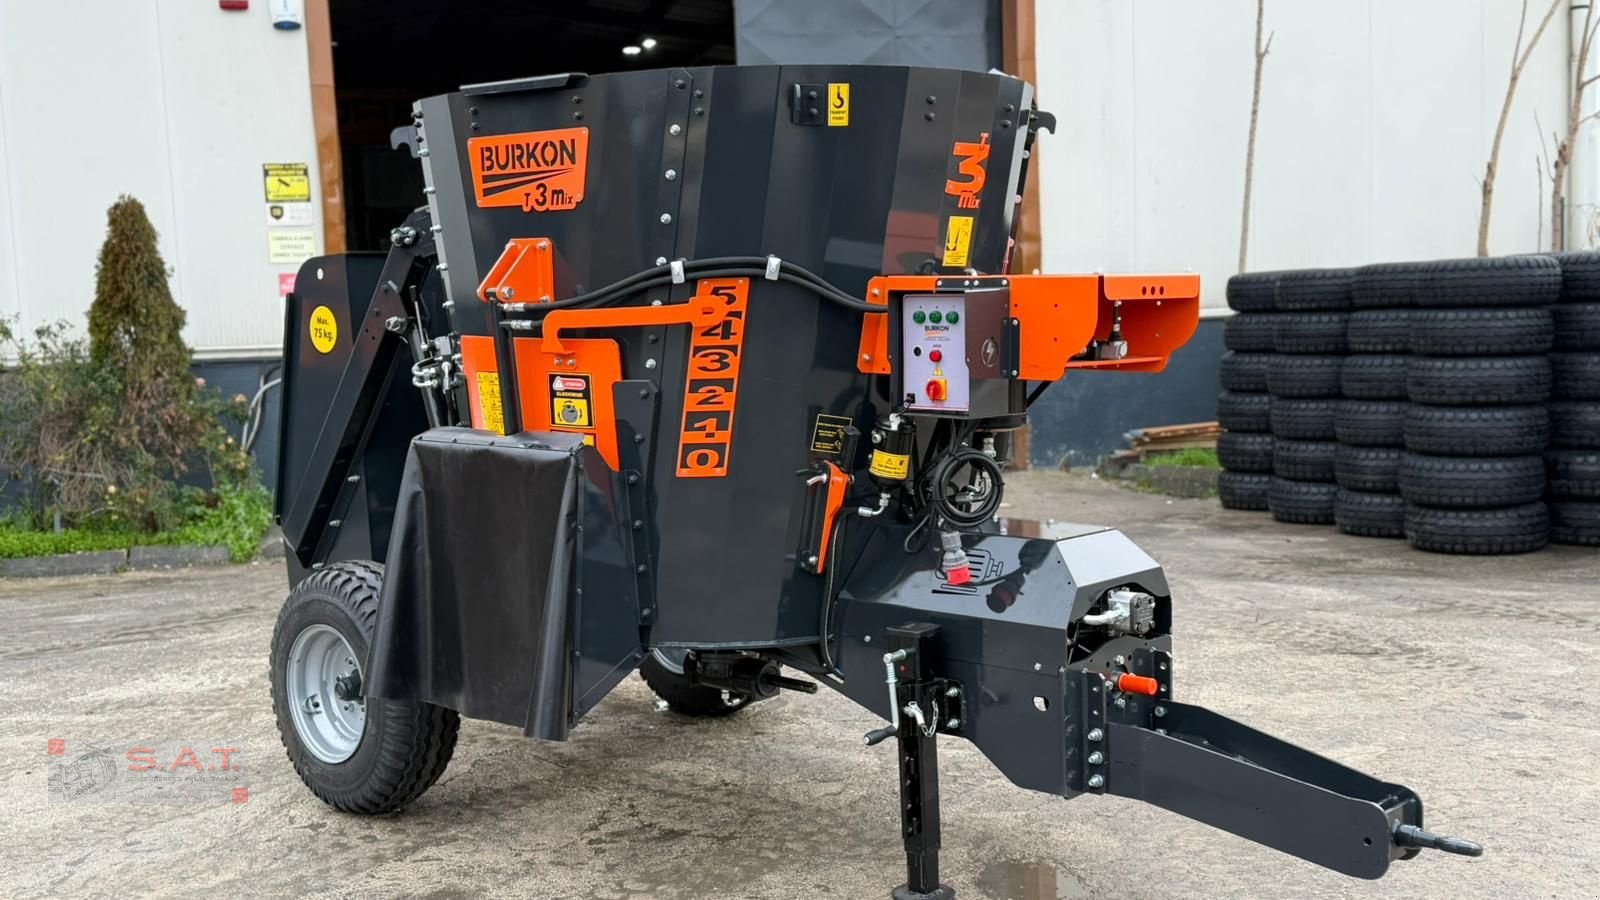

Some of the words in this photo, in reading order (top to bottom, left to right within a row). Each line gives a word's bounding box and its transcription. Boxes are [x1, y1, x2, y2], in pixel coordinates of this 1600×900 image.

[480, 139, 577, 172] BURKON
[945, 142, 991, 196] 3
[535, 183, 548, 207] 3
[710, 286, 737, 306] 5
[317, 315, 330, 325] Max.
[701, 316, 738, 340] 4
[314, 327, 323, 339] 75
[323, 328, 335, 342] kg.
[695, 350, 734, 373] 3
[696, 385, 727, 406] 2
[694, 417, 718, 439] 1
[686, 449, 720, 470] 0
